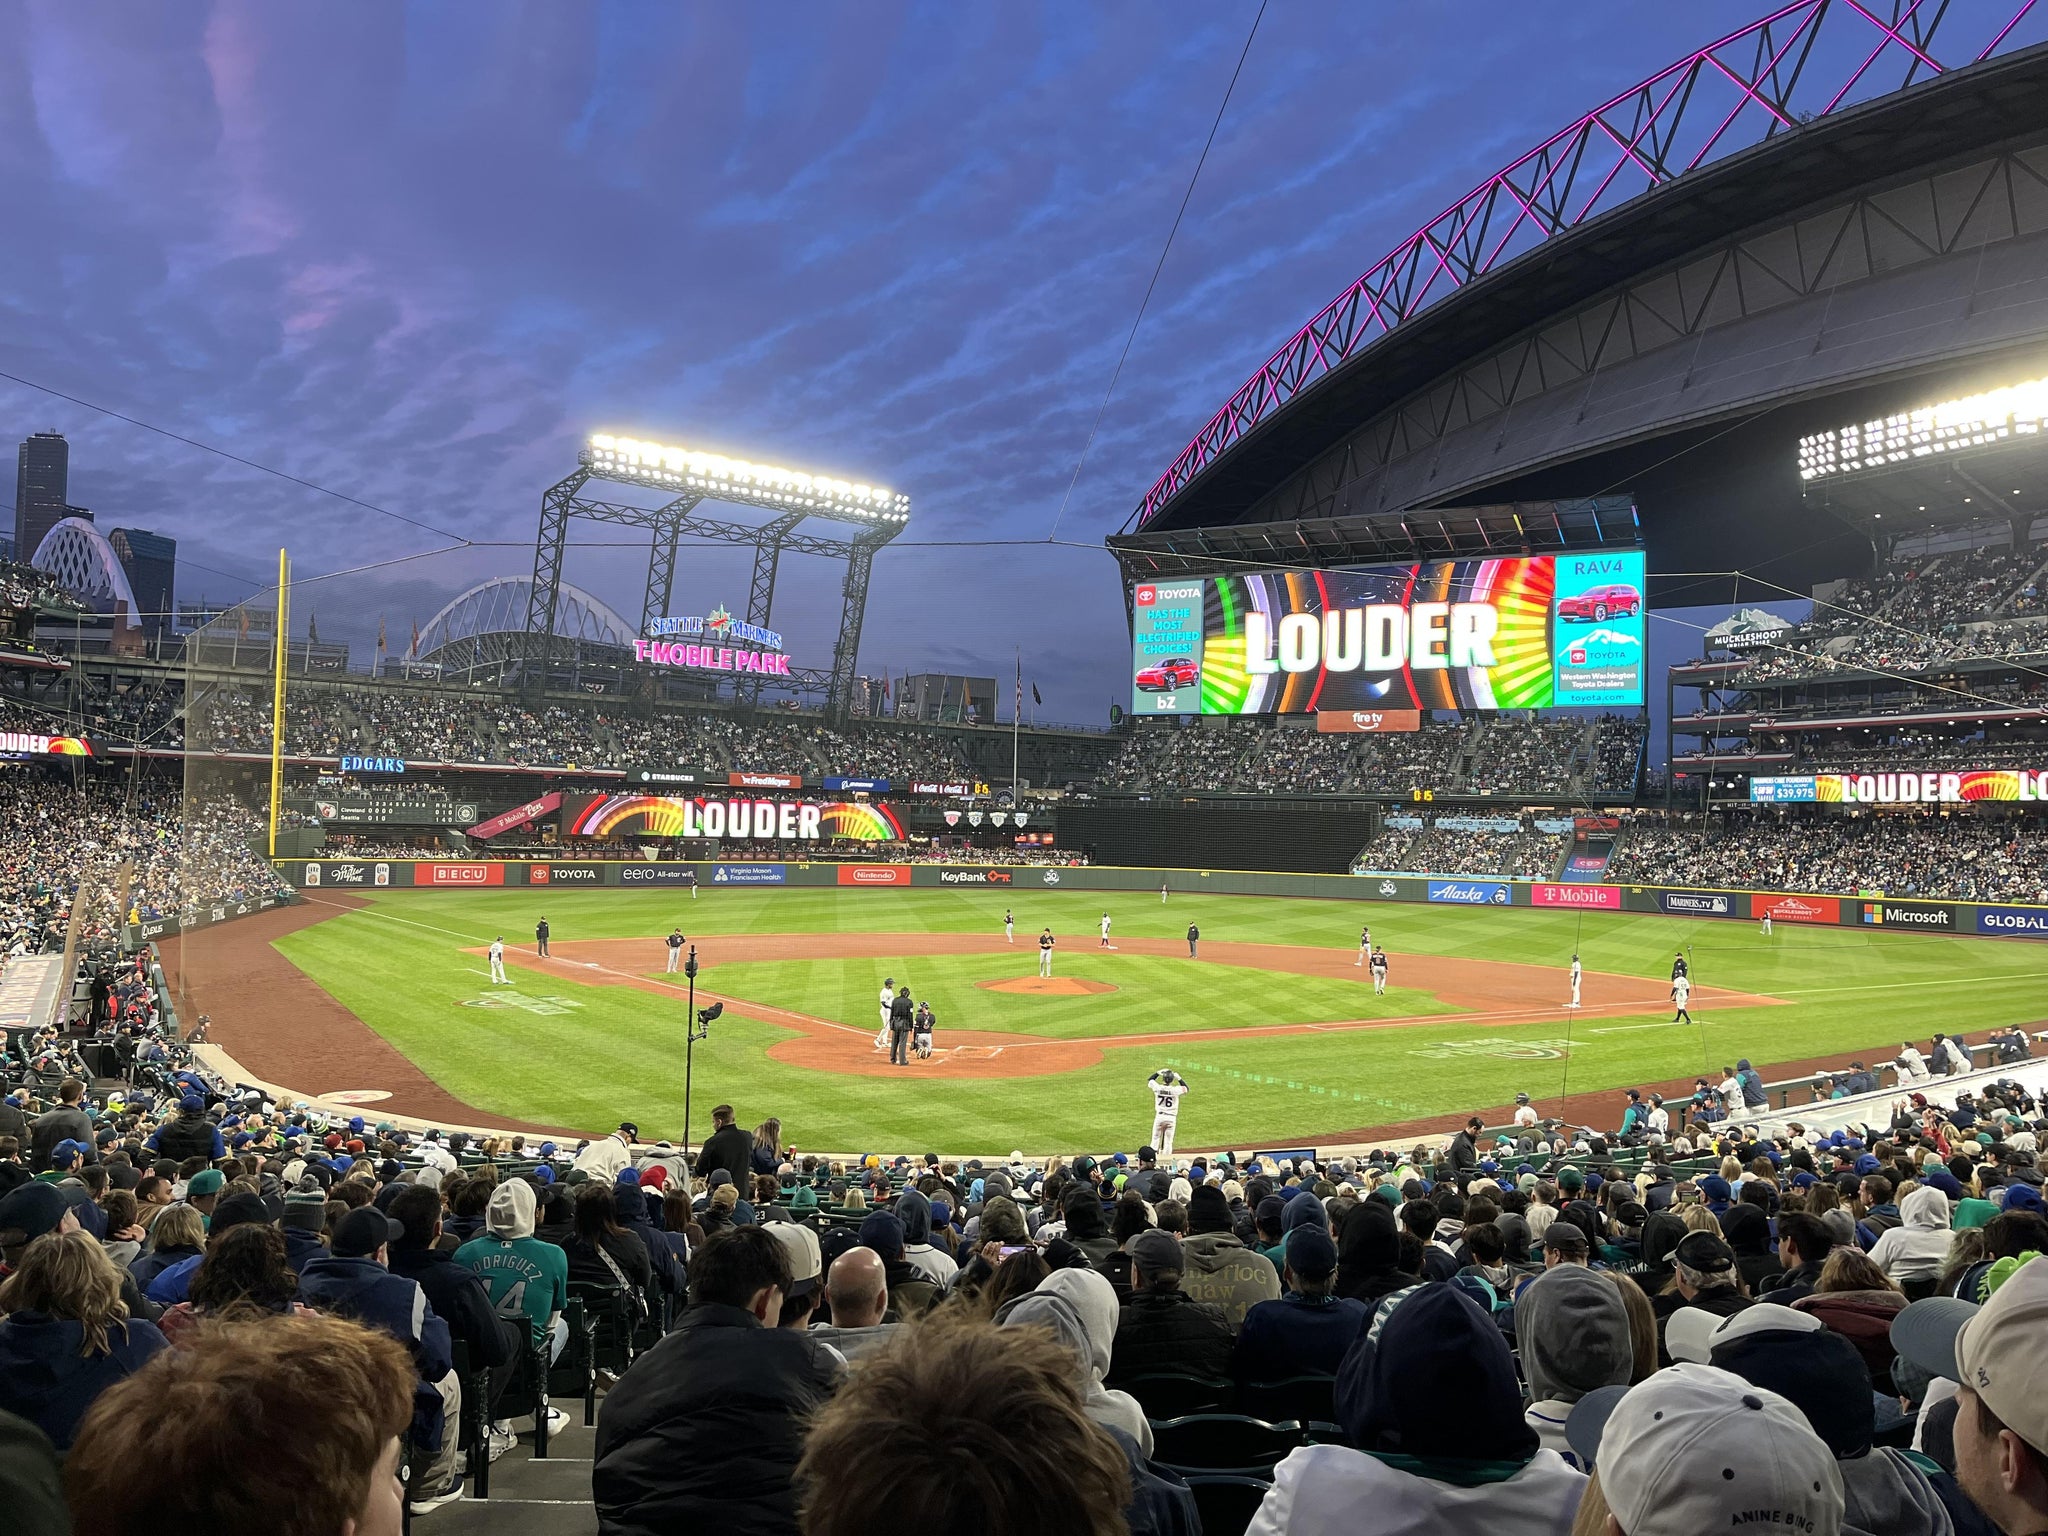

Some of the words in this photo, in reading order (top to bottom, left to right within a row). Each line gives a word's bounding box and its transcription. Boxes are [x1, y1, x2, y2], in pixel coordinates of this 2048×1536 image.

[1574, 559, 1624, 576] RAV4
[1157, 587, 1201, 600] TOYOTA
[1147, 609, 1169, 619] HAS
[1169, 608, 1191, 618] THE
[1153, 620, 1184, 631] MOST
[651, 616, 703, 637] SEATTLE
[731, 619, 783, 650] MARINERS
[1136, 631, 1200, 643] ELECTRIFIED
[1244, 600, 1499, 675] LOUDER
[1714, 630, 1784, 645] MUCKLESHOOT
[1143, 643, 1192, 655] CHOICES!
[633, 639, 733, 671] T-MOBILE
[736, 650, 791, 676] PARK
[1590, 651, 1626, 660] TOYOTA
[1561, 672, 1591, 681] Western
[1591, 671, 1636, 682] Washington
[1572, 681, 1595, 690] Toyota
[1596, 680, 1625, 688] Dealers
[1157, 695, 1176, 709] bZ
[1571, 693, 1625, 702] toyota.com
[1352, 712, 1370, 722] fire
[1370, 713, 1382, 723] tv
[341, 757, 405, 773] EDGARS
[652, 774, 694, 782] STARBUCKS
[1776, 787, 1814, 799] $39,975
[1841, 772, 1961, 803] LOUDER
[683, 797, 821, 839] LOUDER
[438, 869, 484, 879] BECU
[552, 869, 596, 879] TOYOTA
[623, 868, 654, 880] eero
[657, 870, 681, 878] All-star
[729, 867, 751, 875] Virginia
[856, 871, 893, 879] Nintendo
[1046, 872, 1057, 880] 50
[941, 871, 986, 884] KeyBank
[1383, 883, 1394, 891] 50
[1432, 884, 1484, 902] Alaska
[1544, 888, 1556, 901] T
[1560, 888, 1607, 903] Mobile
[1773, 908, 1813, 916] MUCKLESHOOT
[1886, 908, 1948, 924] Microsoft
[1984, 914, 2048, 929] GLOBAL
[1158, 1096, 1172, 1108] 76
[755, 1210, 766, 1220] 23
[472, 1254, 544, 1283] ODRIGUEZ
[1731, 1510, 1781, 1526] ANINE
[1785, 1512, 1816, 1534] BING
